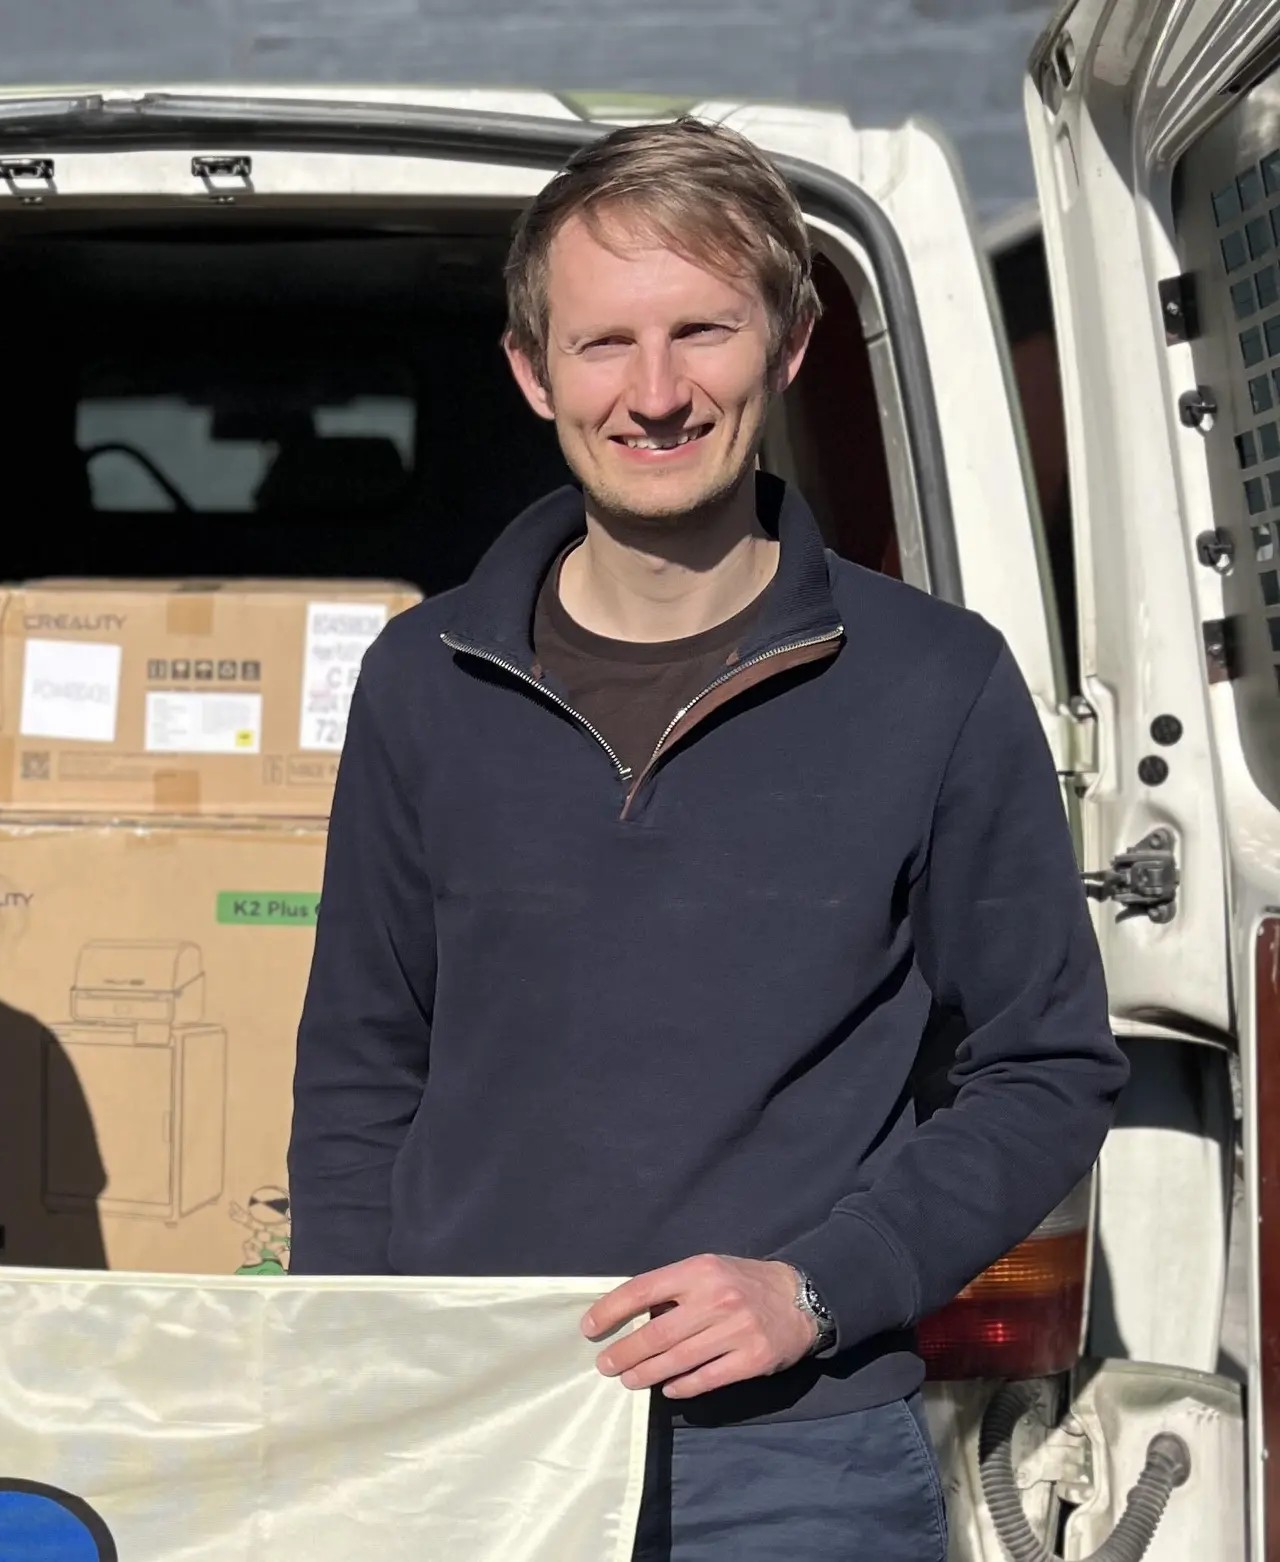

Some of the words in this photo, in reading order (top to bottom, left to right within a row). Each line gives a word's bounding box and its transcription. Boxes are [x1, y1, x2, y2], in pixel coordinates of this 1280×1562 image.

[23, 614, 128, 631] CREALITY
[233, 899, 261, 917] K2
[267, 899, 309, 917] Plus
